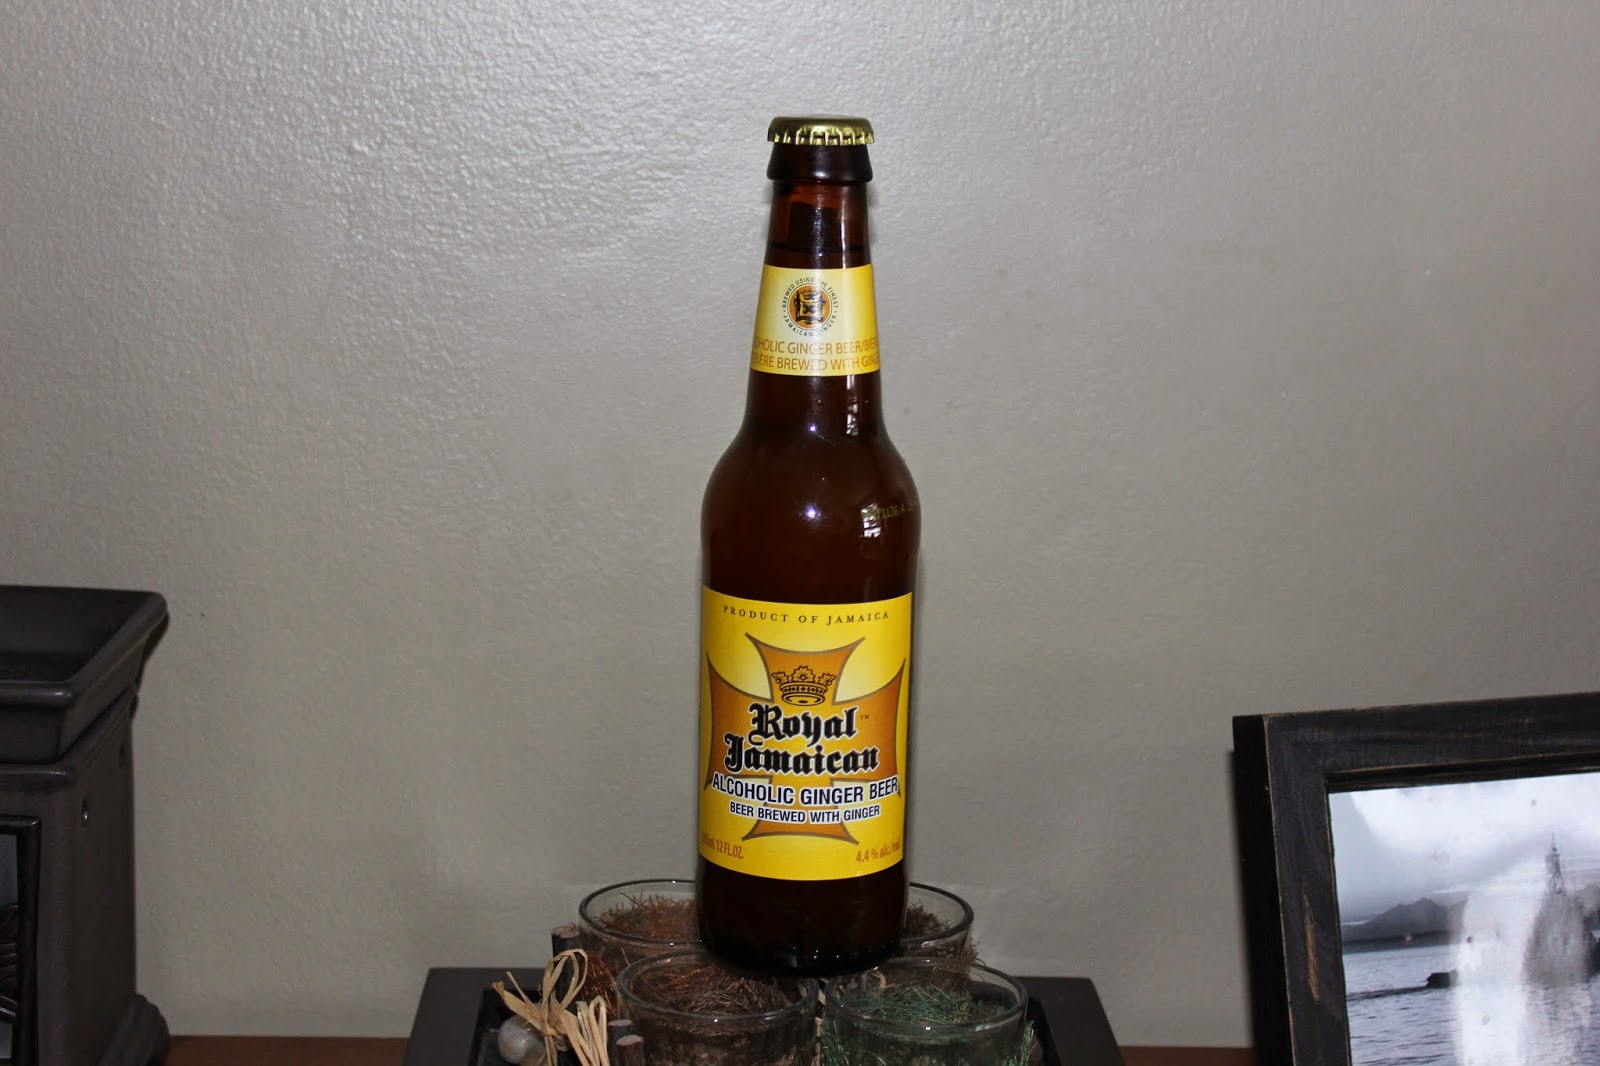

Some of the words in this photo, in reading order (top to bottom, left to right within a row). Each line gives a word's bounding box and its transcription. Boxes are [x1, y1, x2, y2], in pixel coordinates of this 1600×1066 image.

[782, 283, 796, 308] BREWED
[795, 277, 815, 286] USING
[827, 286, 839, 308] FINEST
[783, 315, 814, 337] JAMAICAN
[787, 342, 833, 355] GINGER
[776, 357, 828, 371] BREWED
[830, 357, 860, 370] WITH
[723, 605, 789, 623] PRODUCT
[798, 615, 818, 624] OF
[826, 611, 889, 626] JAMAICA
[748, 702, 858, 748] Royal
[724, 733, 880, 775] Jamaican
[712, 774, 794, 805] ALCOHOLIC
[800, 785, 864, 805] GINGER
[869, 776, 899, 800] BEER
[730, 801, 754, 817] BEER
[758, 809, 806, 823] BREWED
[810, 810, 840, 823] WITH
[843, 804, 880, 821] GINGER
